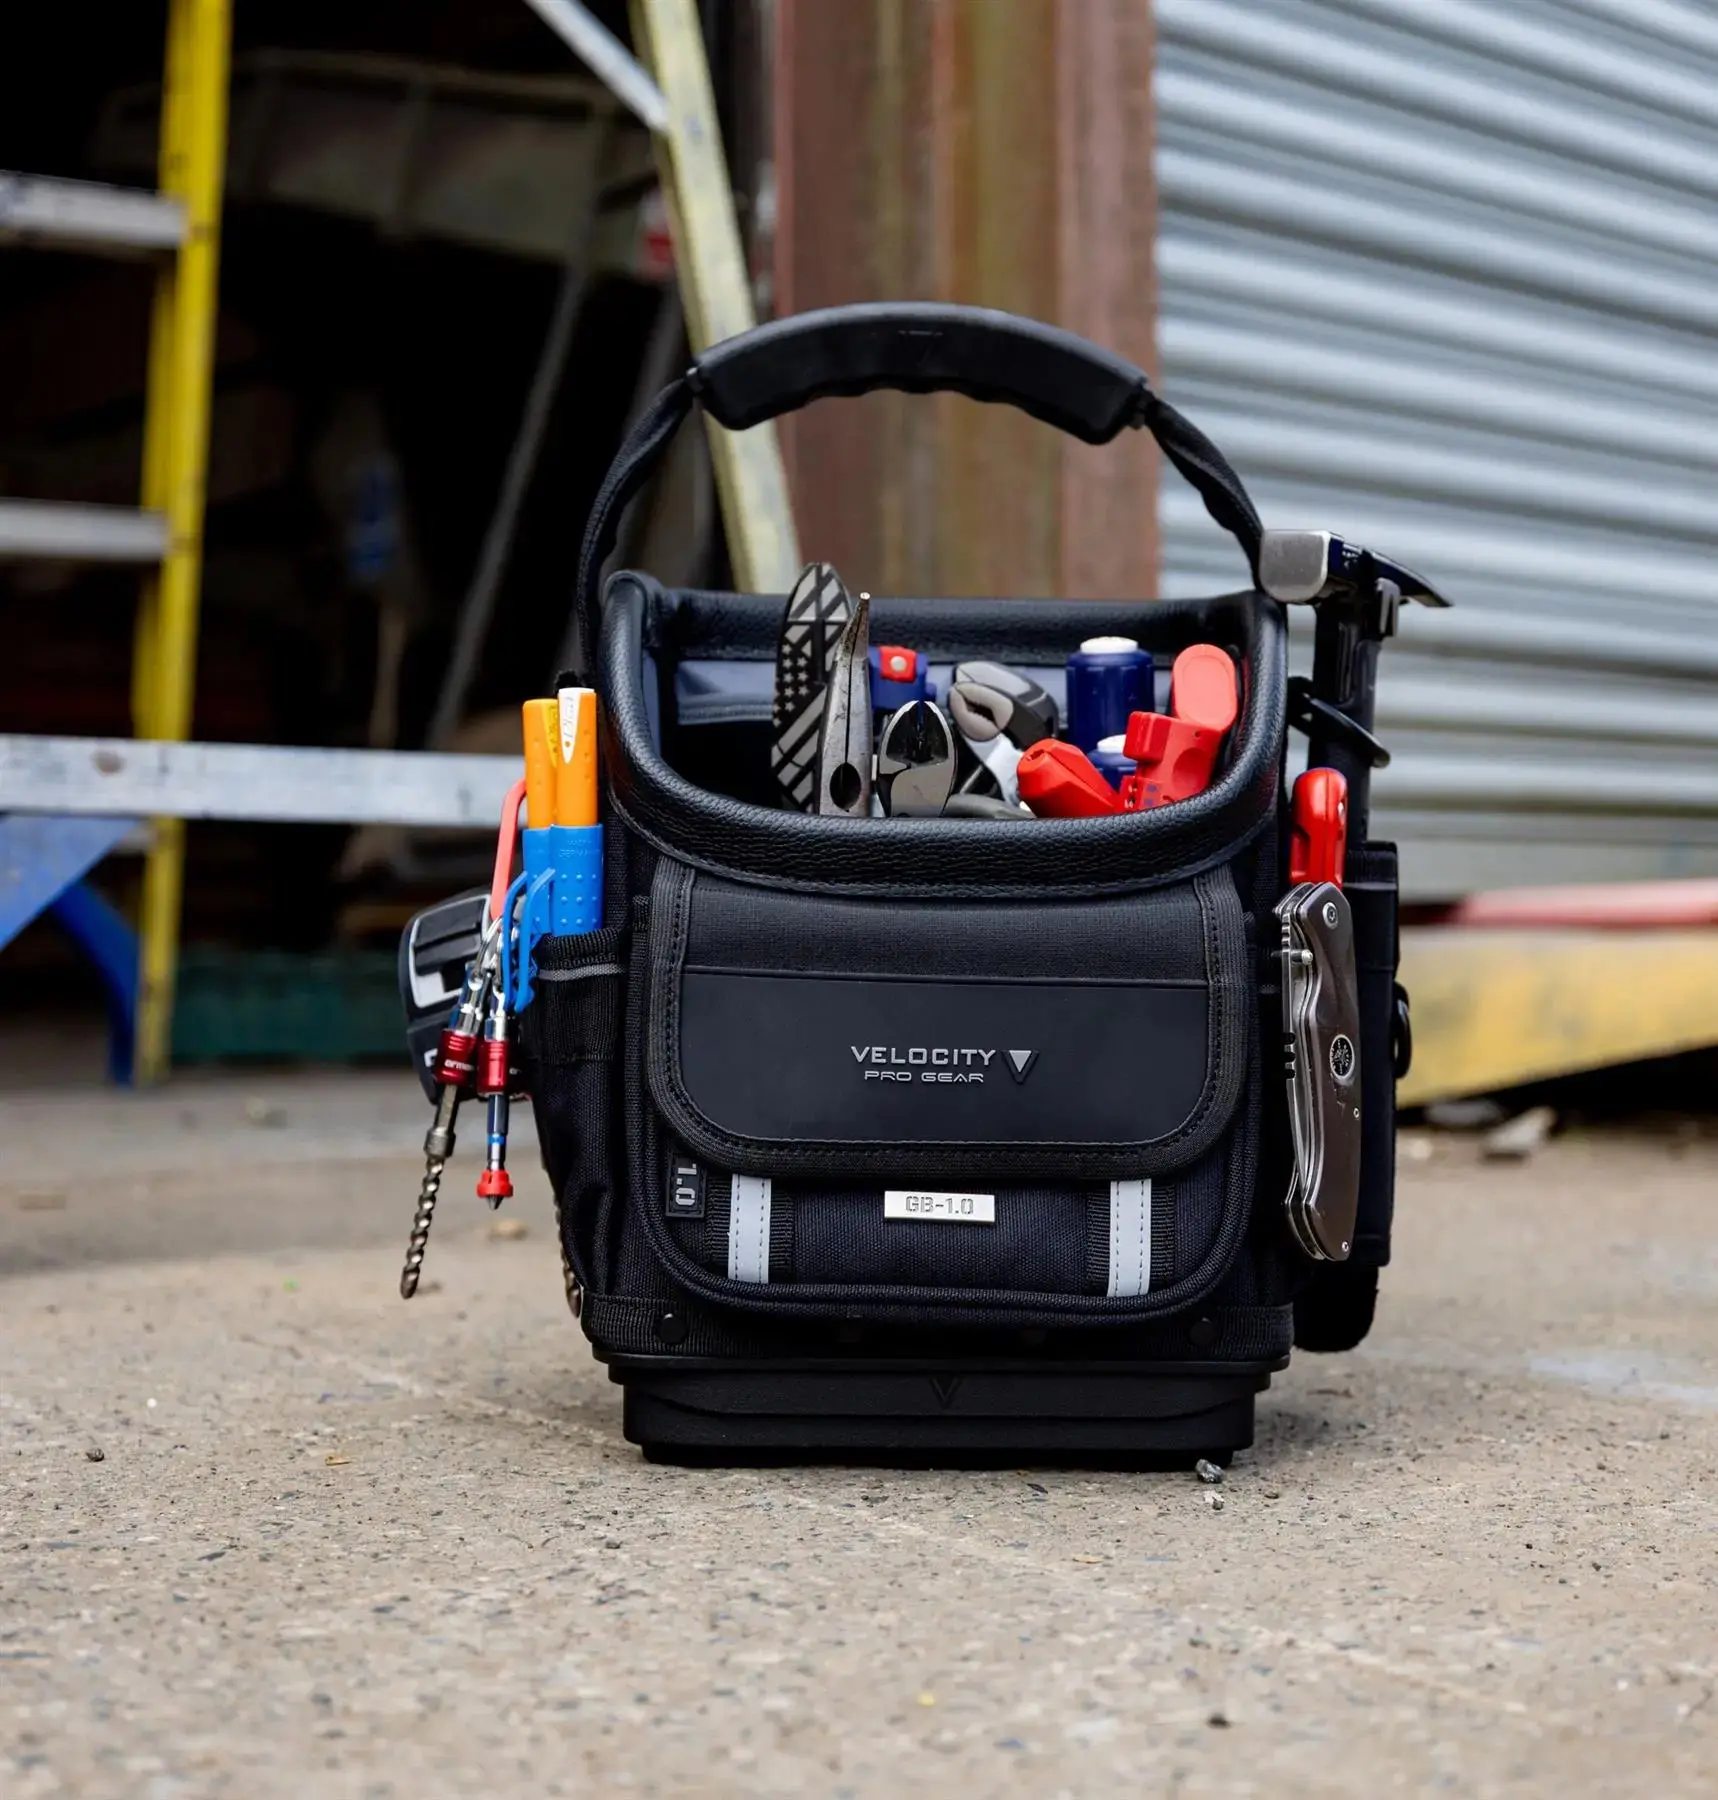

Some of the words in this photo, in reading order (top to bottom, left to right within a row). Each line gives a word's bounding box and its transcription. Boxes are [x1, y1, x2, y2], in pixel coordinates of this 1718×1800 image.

[850, 1046, 996, 1066] VELOCITY
[864, 1070, 912, 1082] PRO
[921, 1072, 984, 1083] GEAR
[905, 1195, 974, 1215] GB-1.0
